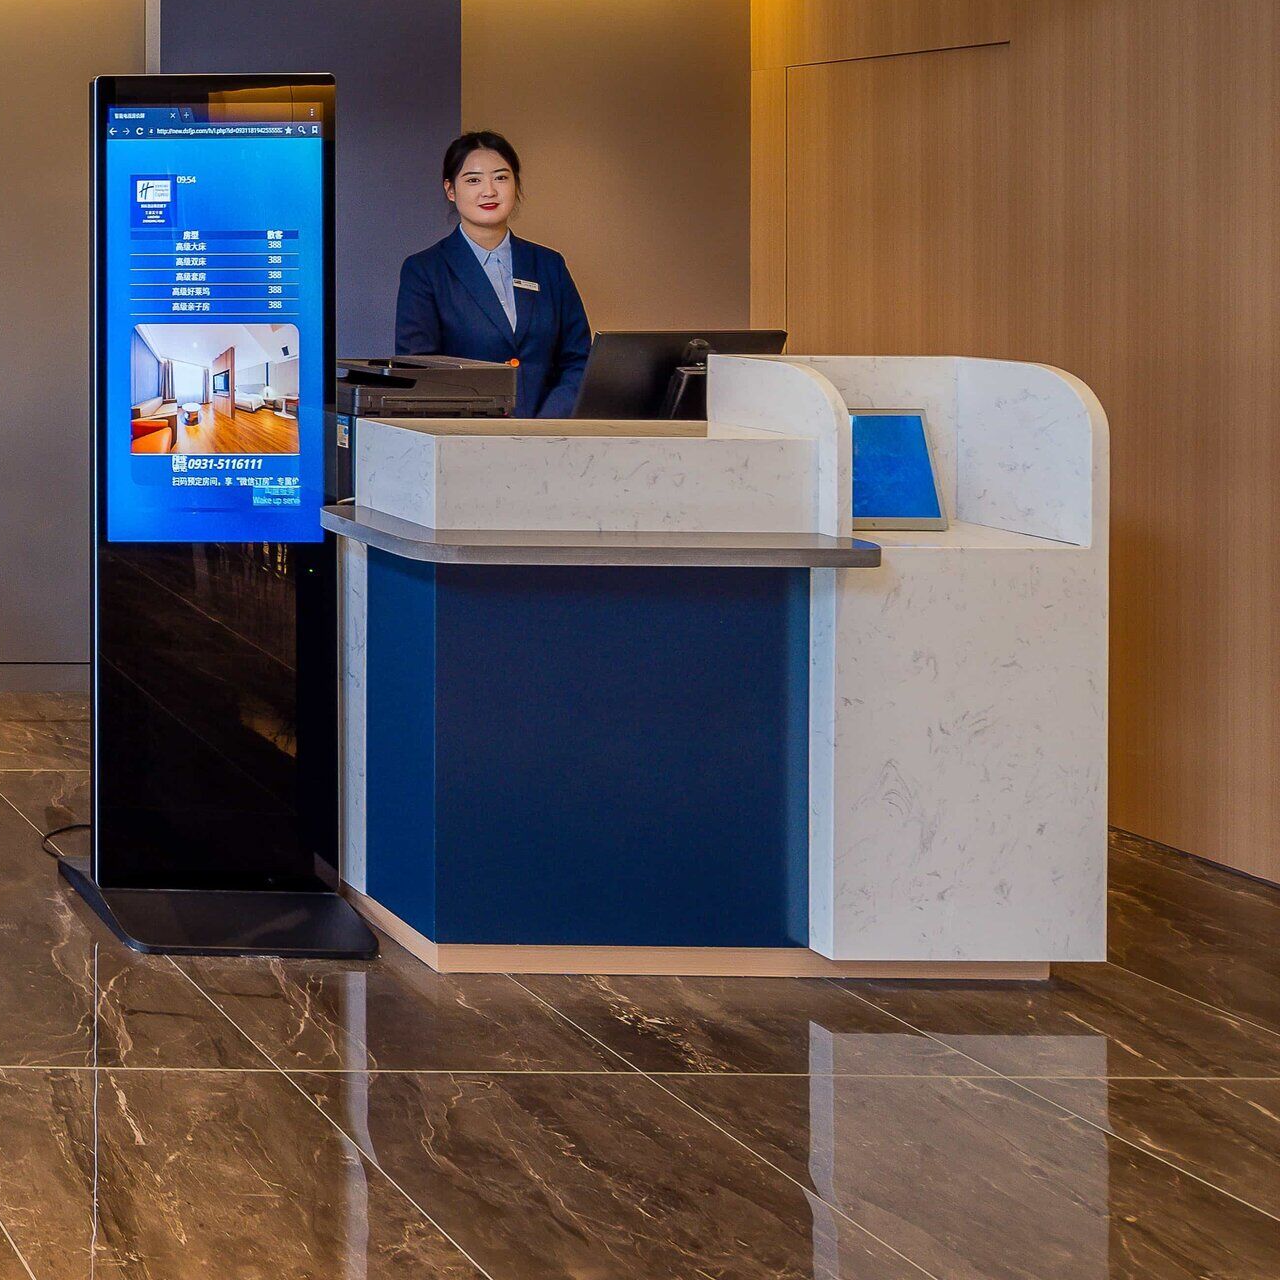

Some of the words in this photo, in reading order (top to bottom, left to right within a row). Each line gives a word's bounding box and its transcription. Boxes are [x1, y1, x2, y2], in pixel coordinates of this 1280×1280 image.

[175, 242, 207, 251] 高级大床
[267, 241, 282, 249] 388
[175, 257, 207, 266] 高级双床
[267, 256, 282, 264] 388
[267, 271, 282, 279] 388
[267, 286, 282, 294] 388
[267, 301, 282, 309] 388
[187, 458, 263, 470] 0931-5116111
